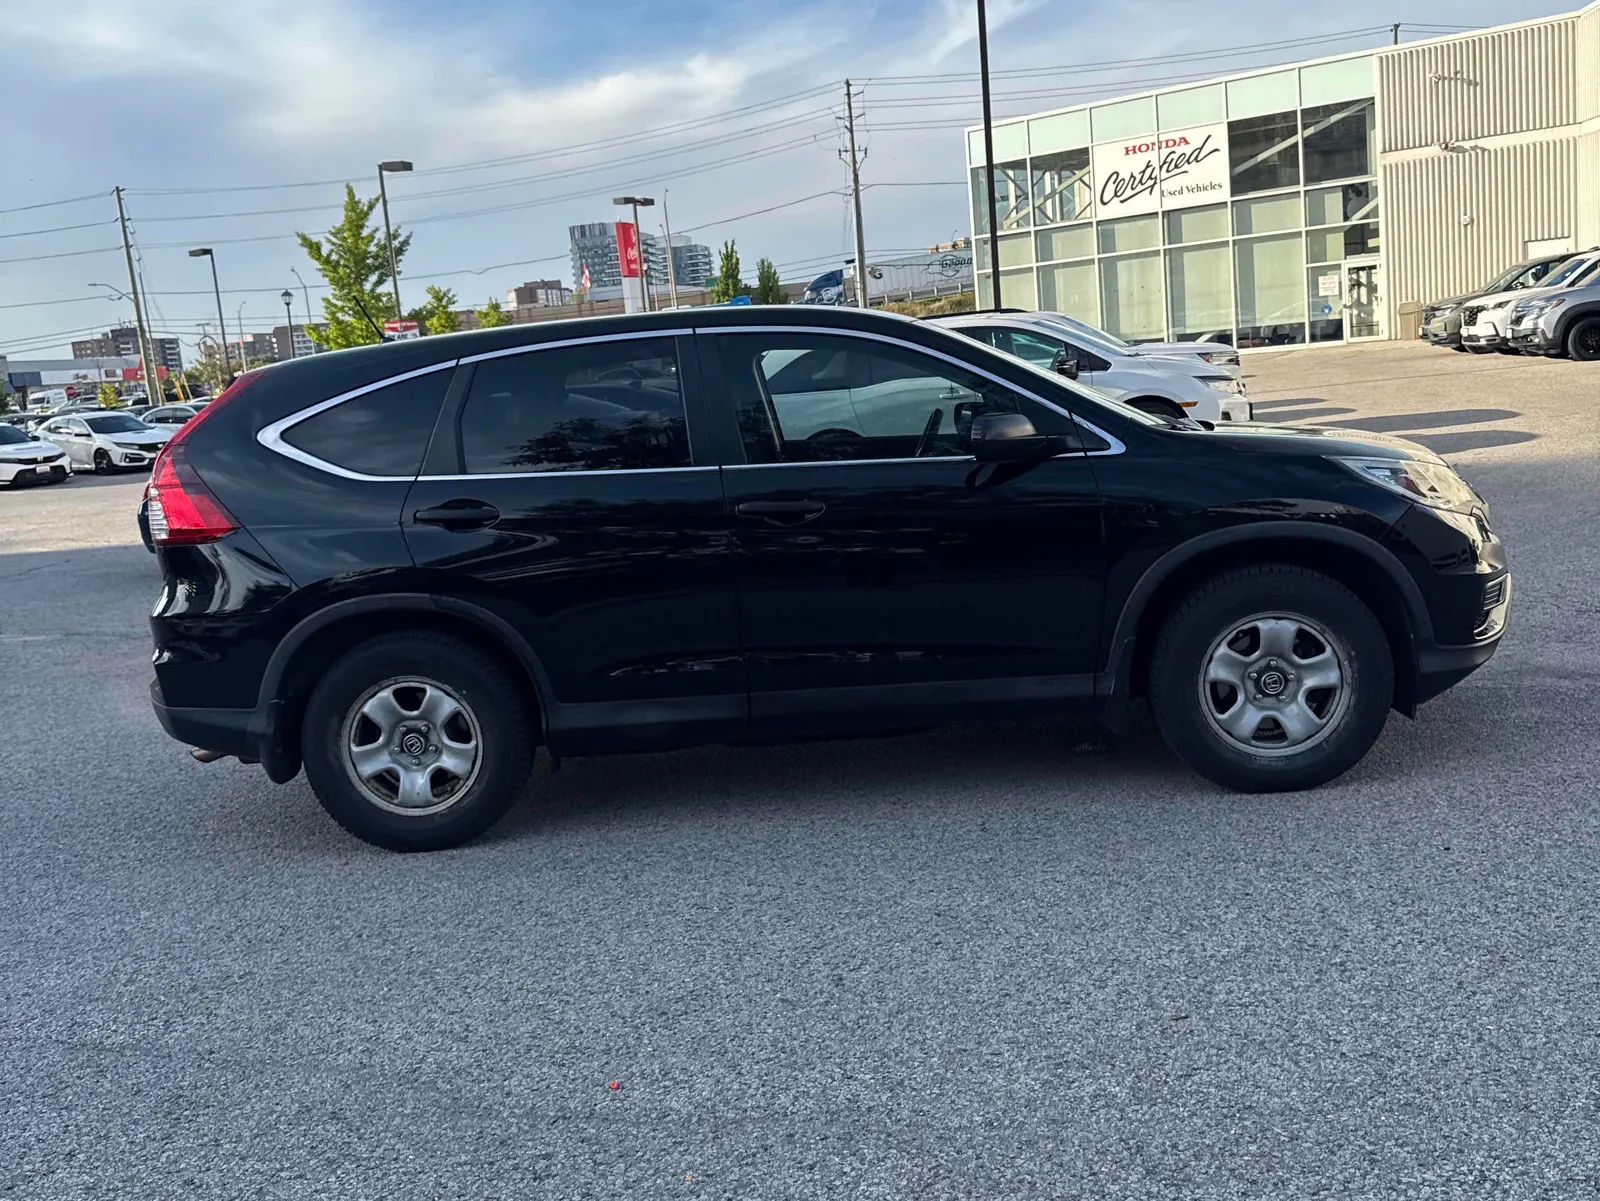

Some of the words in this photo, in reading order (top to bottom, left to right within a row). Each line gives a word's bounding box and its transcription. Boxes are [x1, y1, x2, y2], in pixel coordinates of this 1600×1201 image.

[1124, 136, 1190, 156] HONDA
[1100, 134, 1220, 206] Certified
[1161, 185, 1184, 198] Used
[1185, 181, 1223, 194] Vehicles
